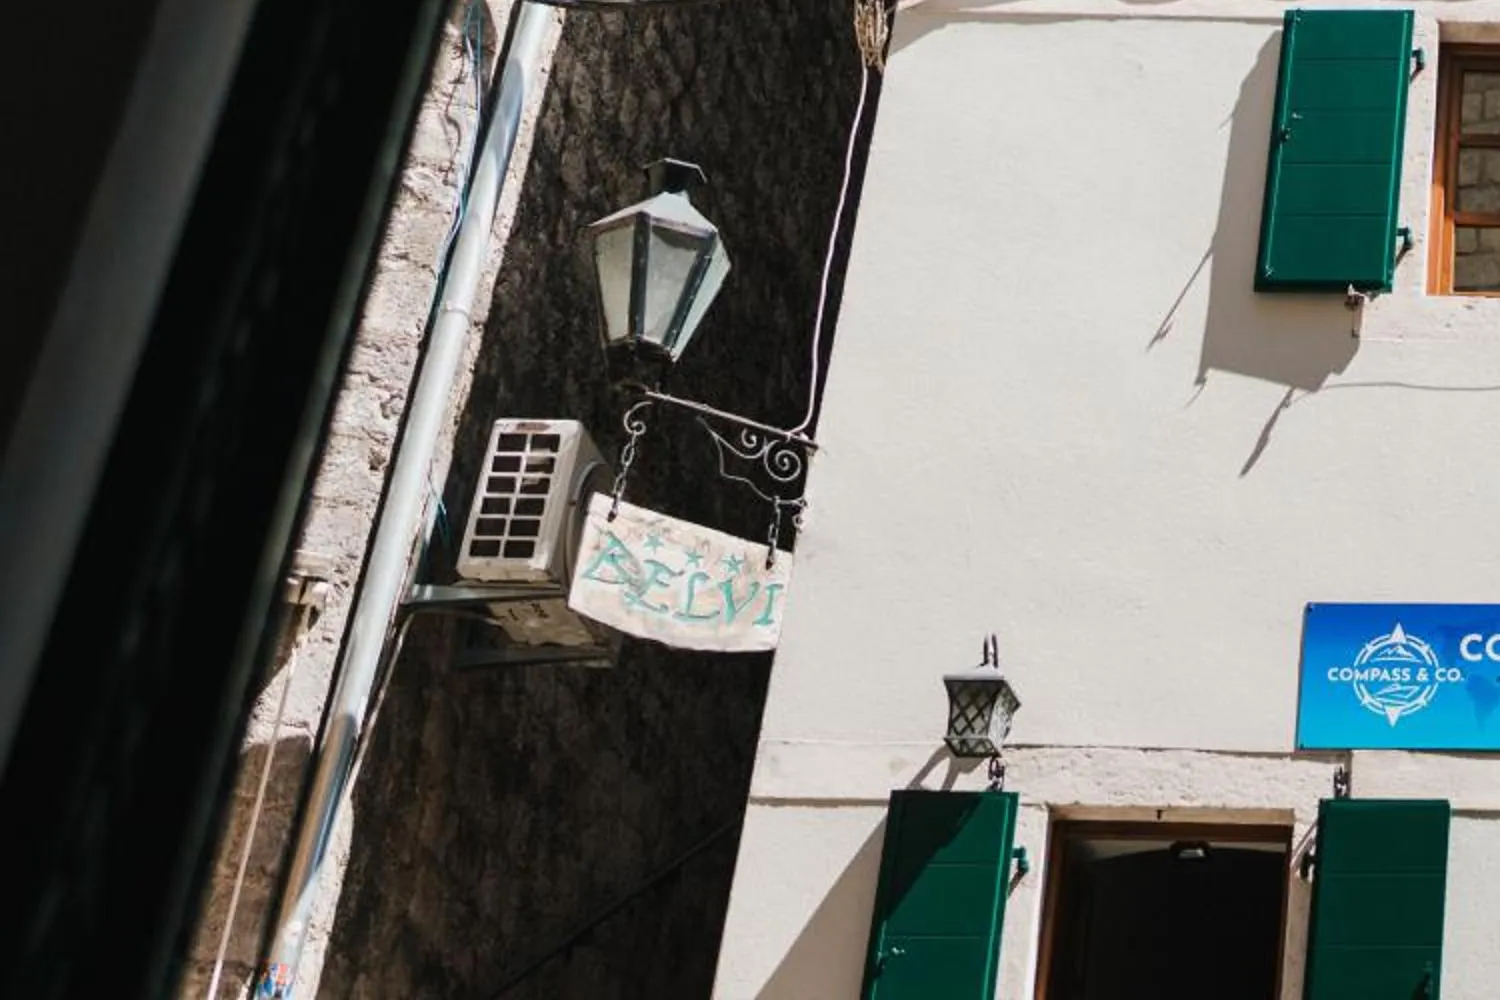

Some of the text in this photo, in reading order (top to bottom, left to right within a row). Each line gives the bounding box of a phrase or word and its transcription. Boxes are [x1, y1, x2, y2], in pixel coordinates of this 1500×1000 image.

[1327, 667, 1465, 682] COMPASS & CO.
